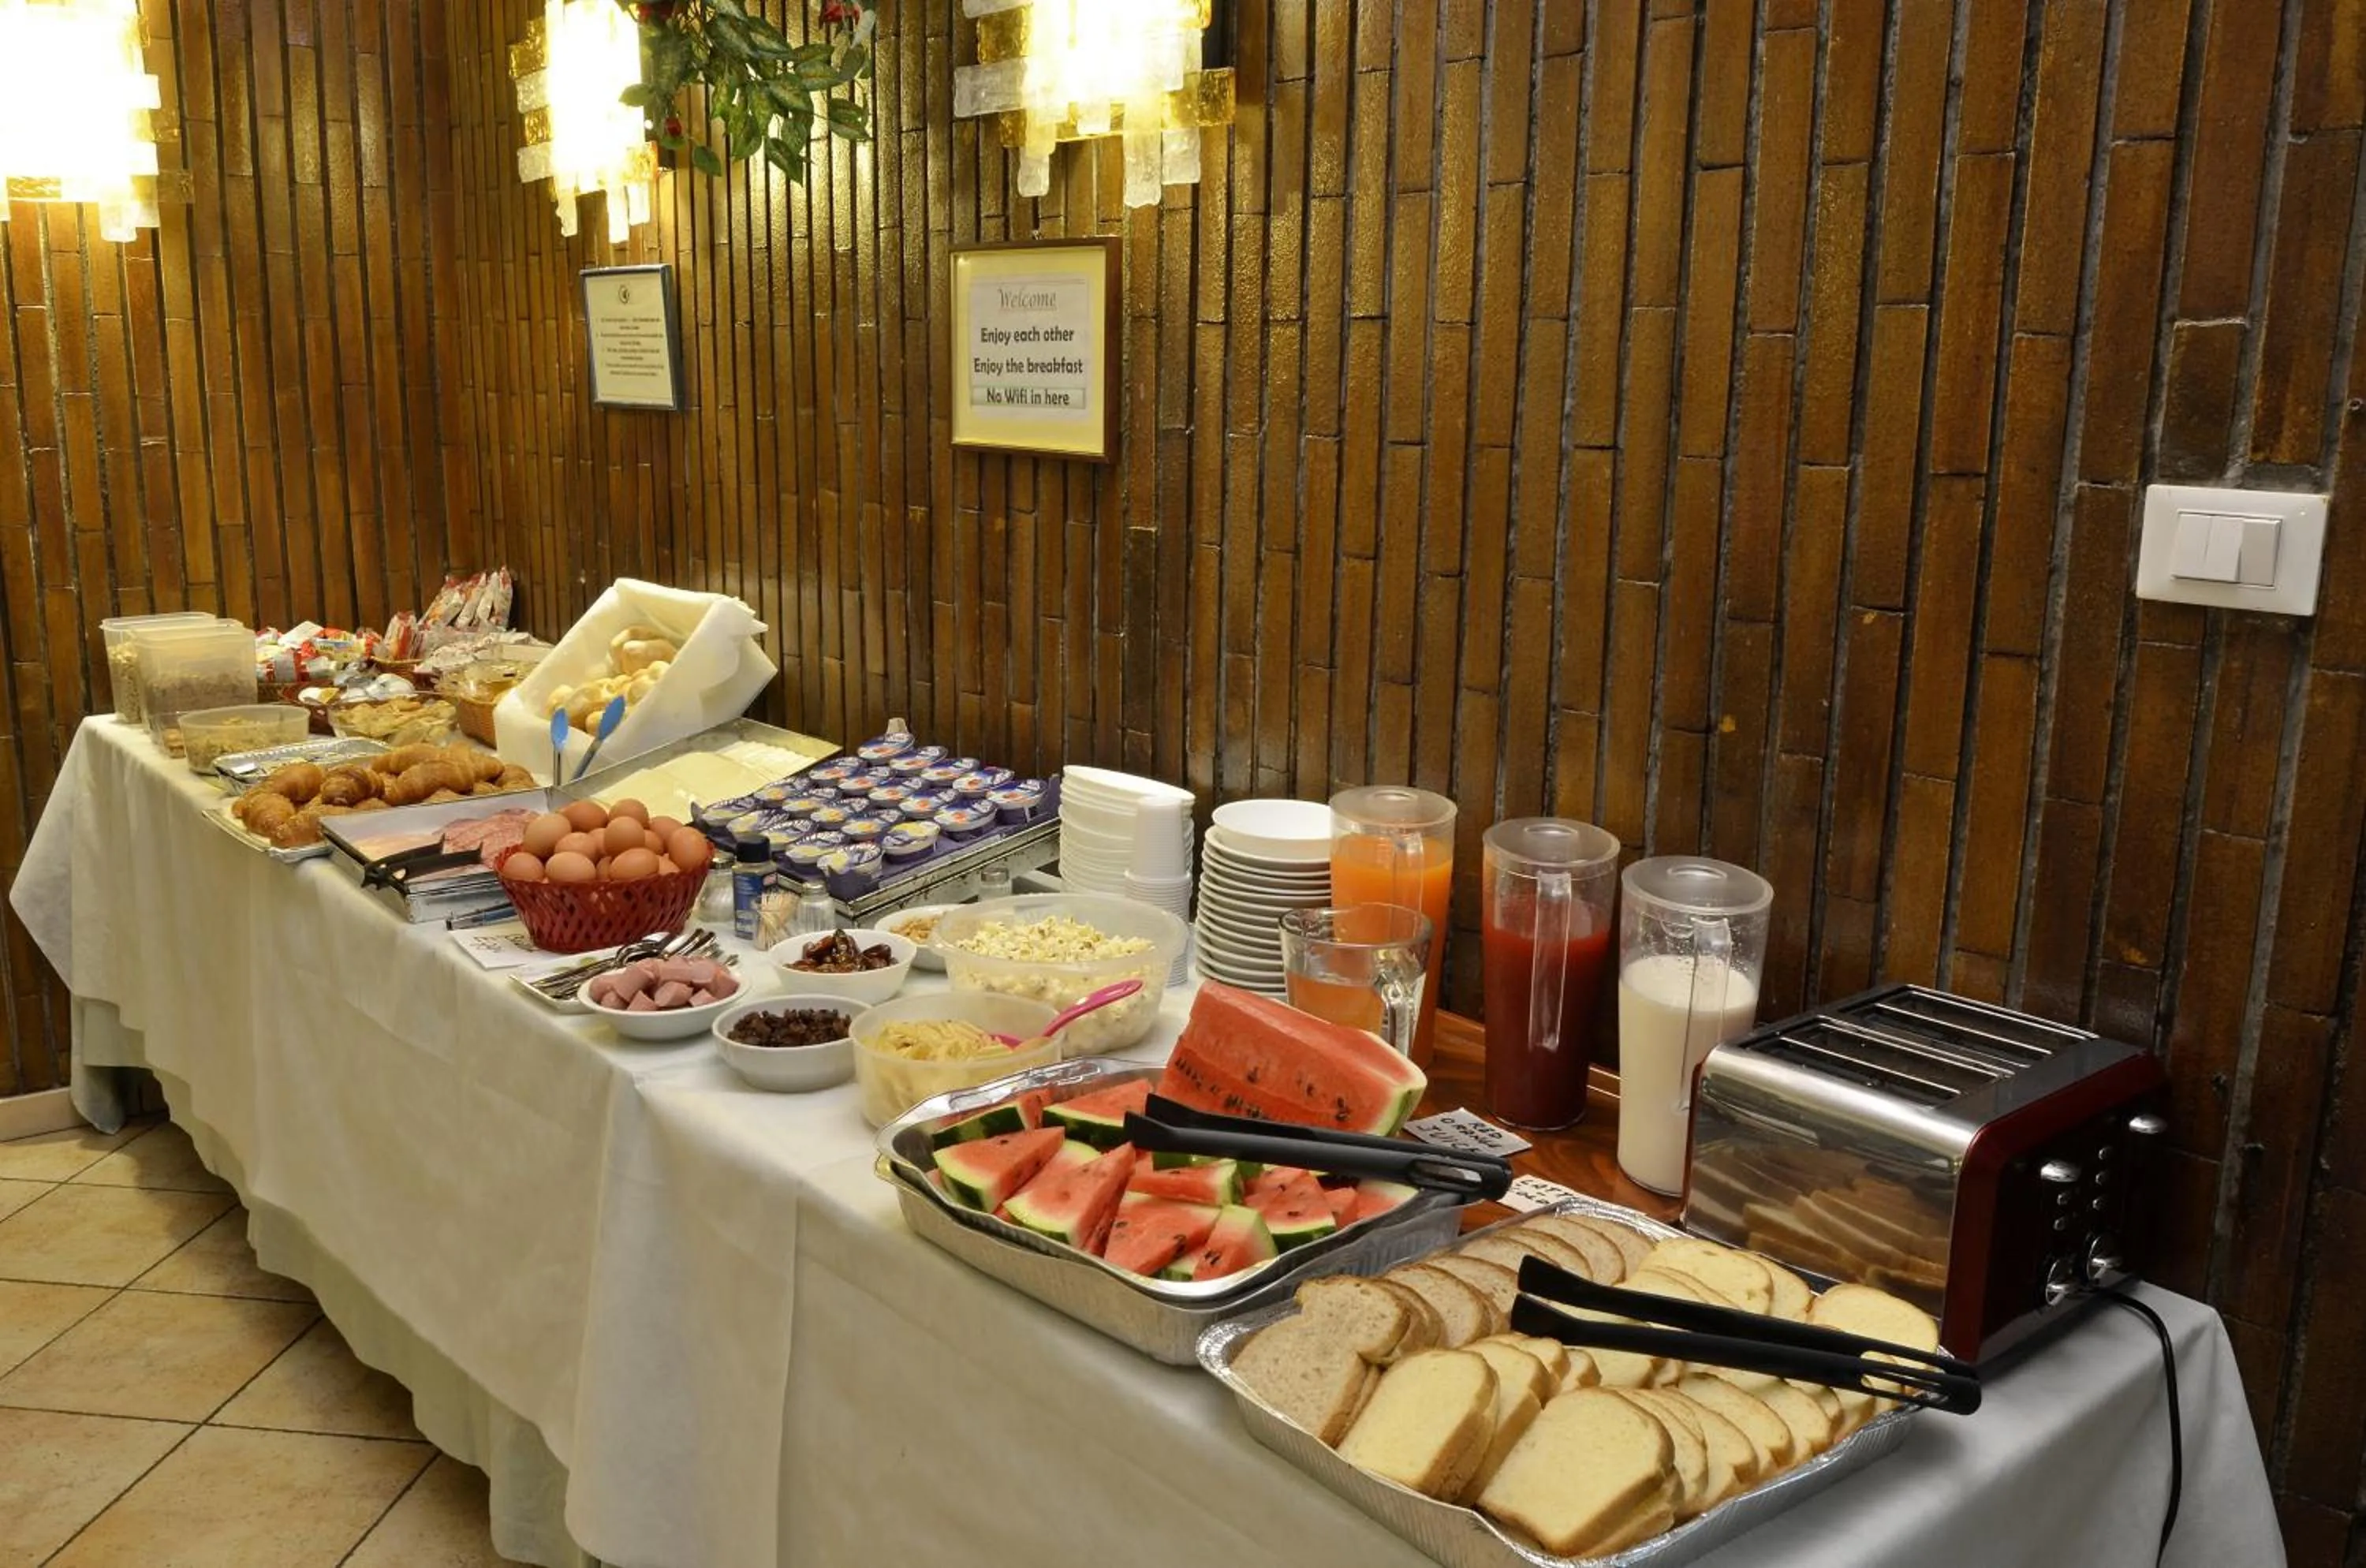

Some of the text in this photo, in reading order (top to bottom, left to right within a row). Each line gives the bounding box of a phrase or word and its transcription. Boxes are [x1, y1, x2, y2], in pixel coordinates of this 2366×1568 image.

[998, 287, 1056, 308] Welcome
[980, 325, 1074, 345] Enjoy each other
[974, 356, 1083, 376] Enjoy the breakfast
[987, 387, 1002, 403] No
[1031, 389, 1042, 405] in
[1044, 388, 1070, 405] here
